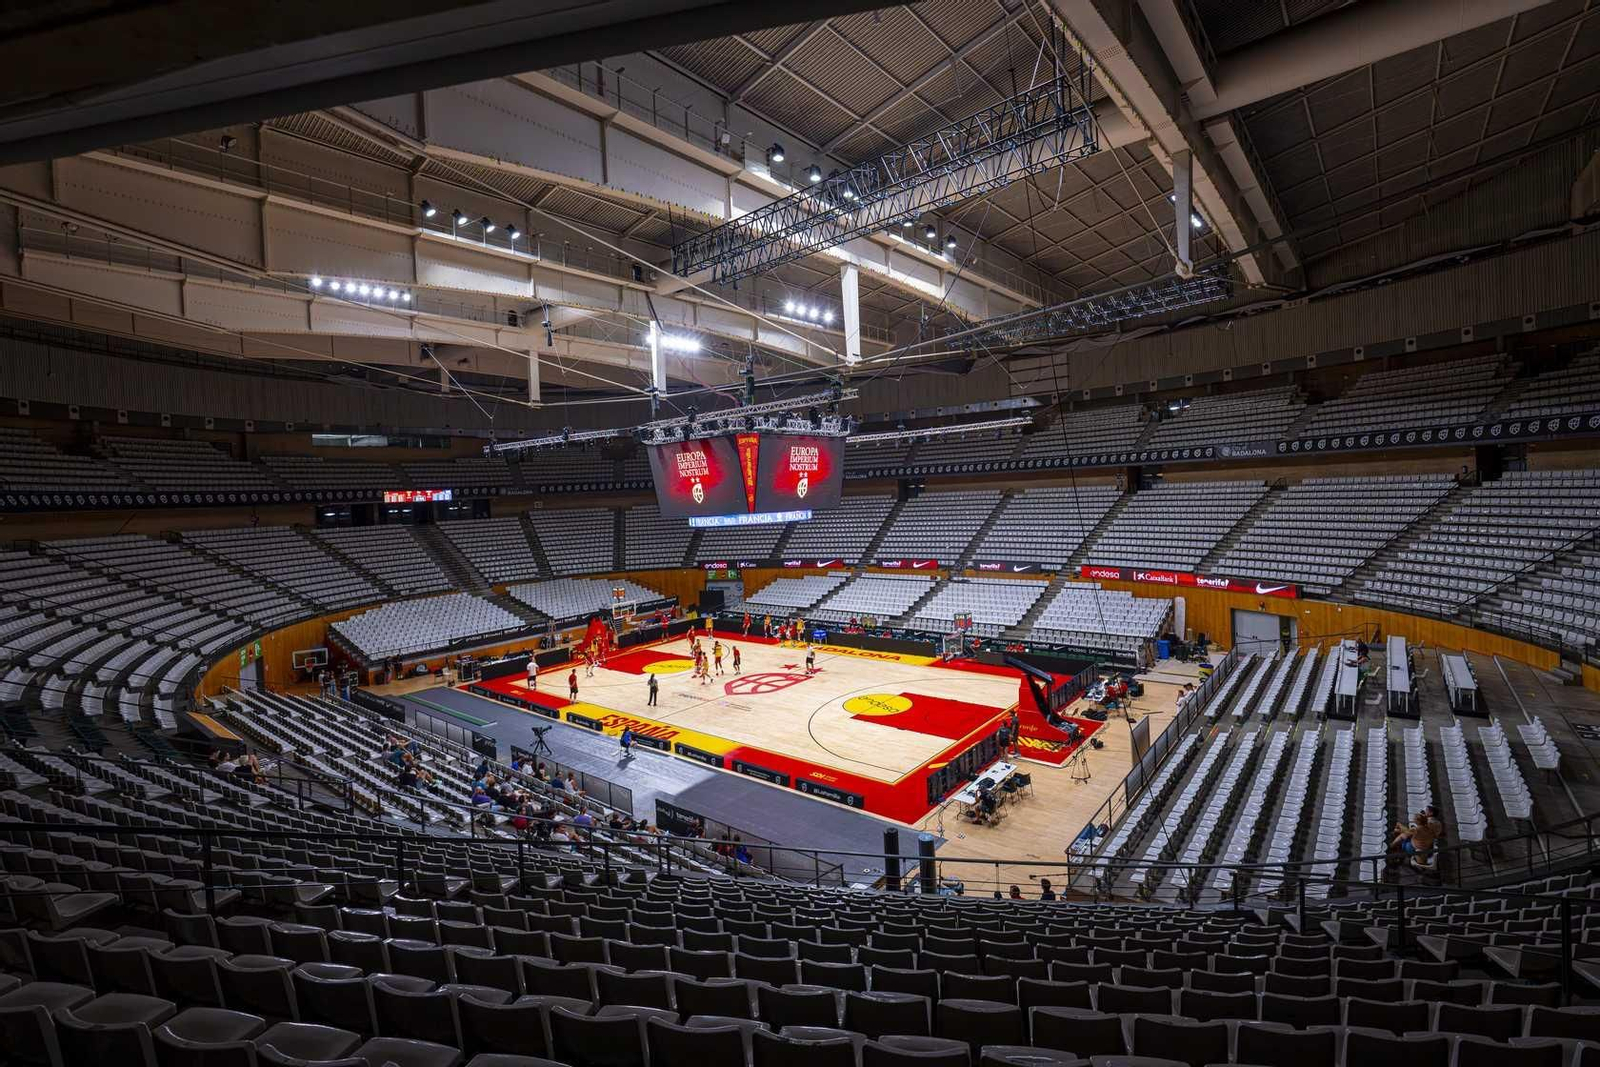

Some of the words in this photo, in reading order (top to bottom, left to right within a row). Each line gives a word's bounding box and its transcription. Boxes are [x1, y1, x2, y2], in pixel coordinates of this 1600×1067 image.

[791, 446, 819, 456] EUROPA
[676, 451, 706, 462] EUROPA
[790, 455, 819, 463] IMPERIUM
[678, 460, 707, 470] IMPERIUM
[789, 463, 818, 471] NOSTRUM
[680, 468, 709, 478] NOSTRUM
[739, 514, 773, 524] FRANCIA
[1089, 570, 1120, 579] endesa
[1145, 573, 1175, 583] CaixaBank
[599, 714, 681, 740] ESPAÑA
